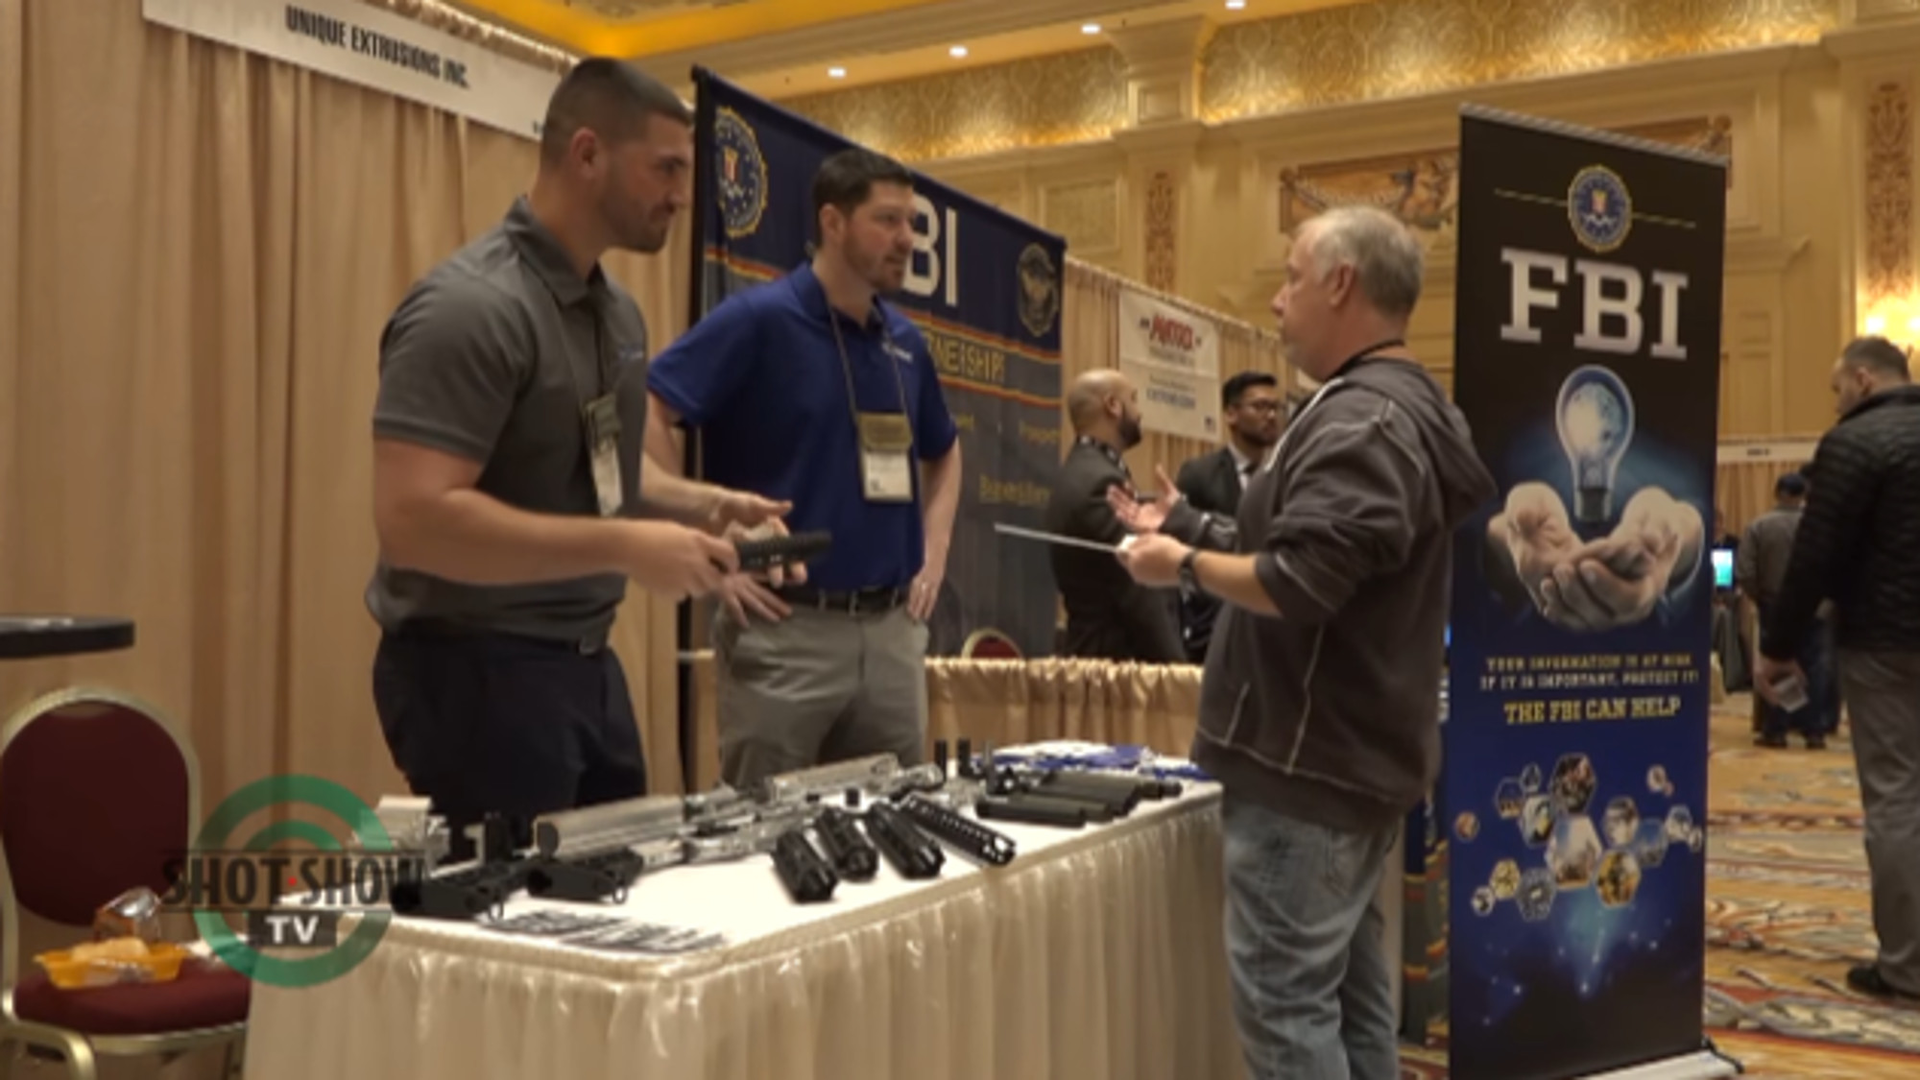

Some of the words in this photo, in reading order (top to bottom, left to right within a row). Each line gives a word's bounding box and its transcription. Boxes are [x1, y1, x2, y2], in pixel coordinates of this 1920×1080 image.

[285, 5, 347, 50] UNIQUE
[351, 25, 440, 79] EXTRUSIONS
[443, 57, 470, 89] INC.
[901, 193, 958, 307] BI
[1501, 247, 1688, 359] FBI
[1480, 675, 1496, 691] IF
[1622, 670, 1678, 686] PROTECT
[1486, 656, 1524, 672] YOUR
[1530, 654, 1620, 670] INFORMATION
[1504, 700, 1545, 725] THE
[1549, 699, 1581, 723] FBI
[1585, 697, 1627, 720] CAN
[1630, 695, 1681, 719] HELP
